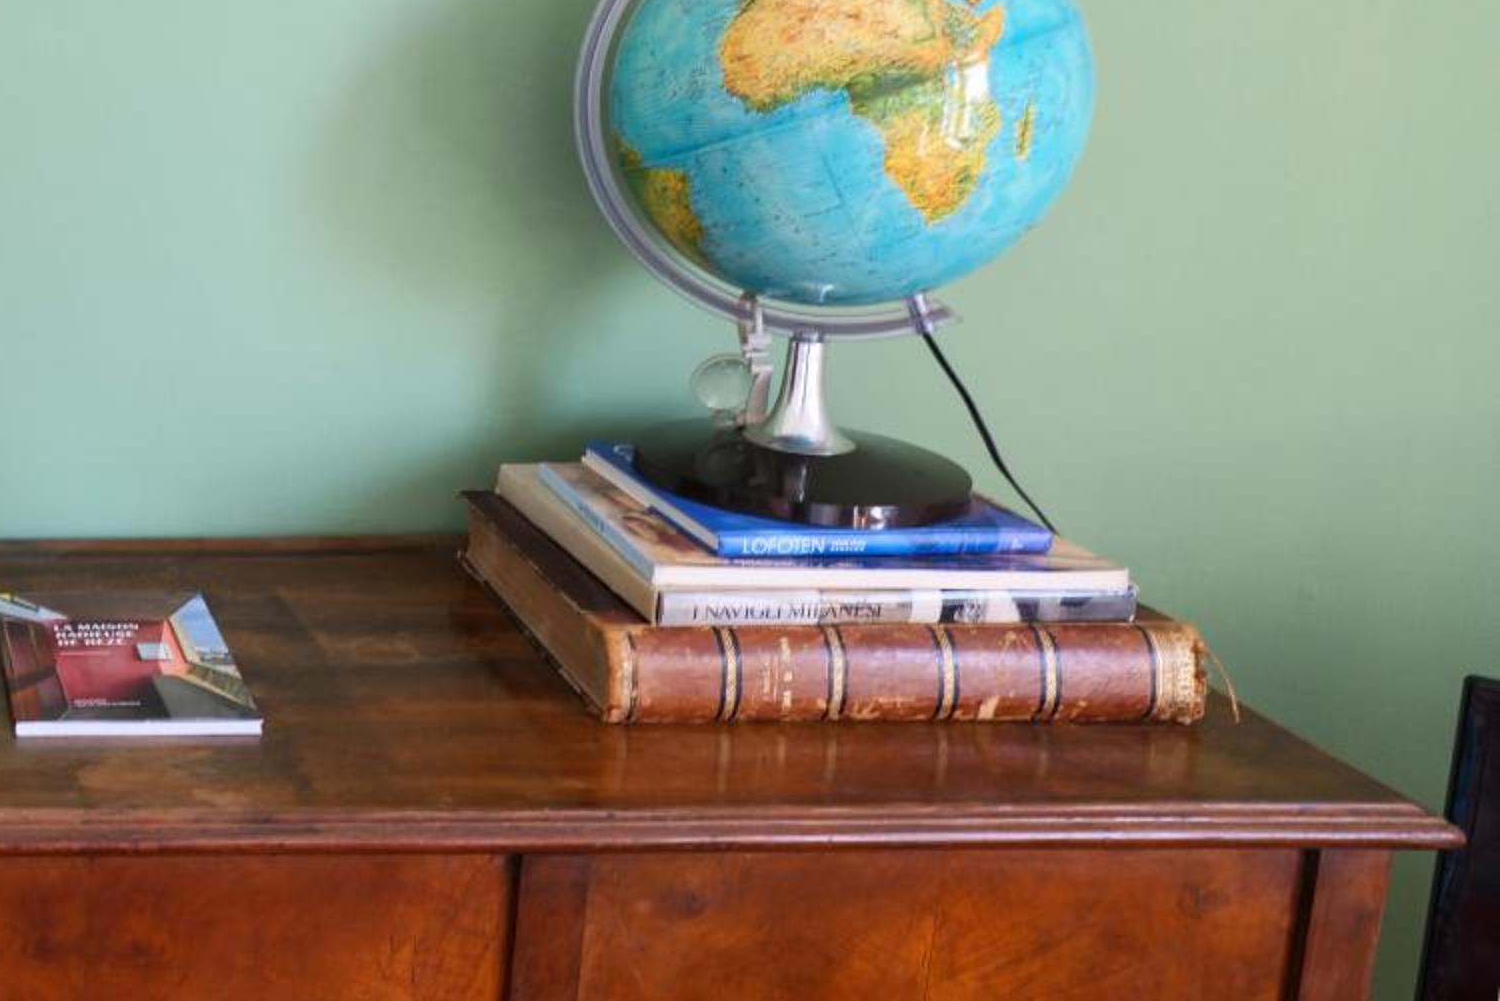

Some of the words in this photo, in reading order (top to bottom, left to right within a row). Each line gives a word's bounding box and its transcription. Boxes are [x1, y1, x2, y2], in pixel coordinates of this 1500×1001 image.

[742, 535, 826, 554] LOFOTEN
[705, 604, 782, 620] NAVIGLI
[787, 602, 882, 620] MILANESI
